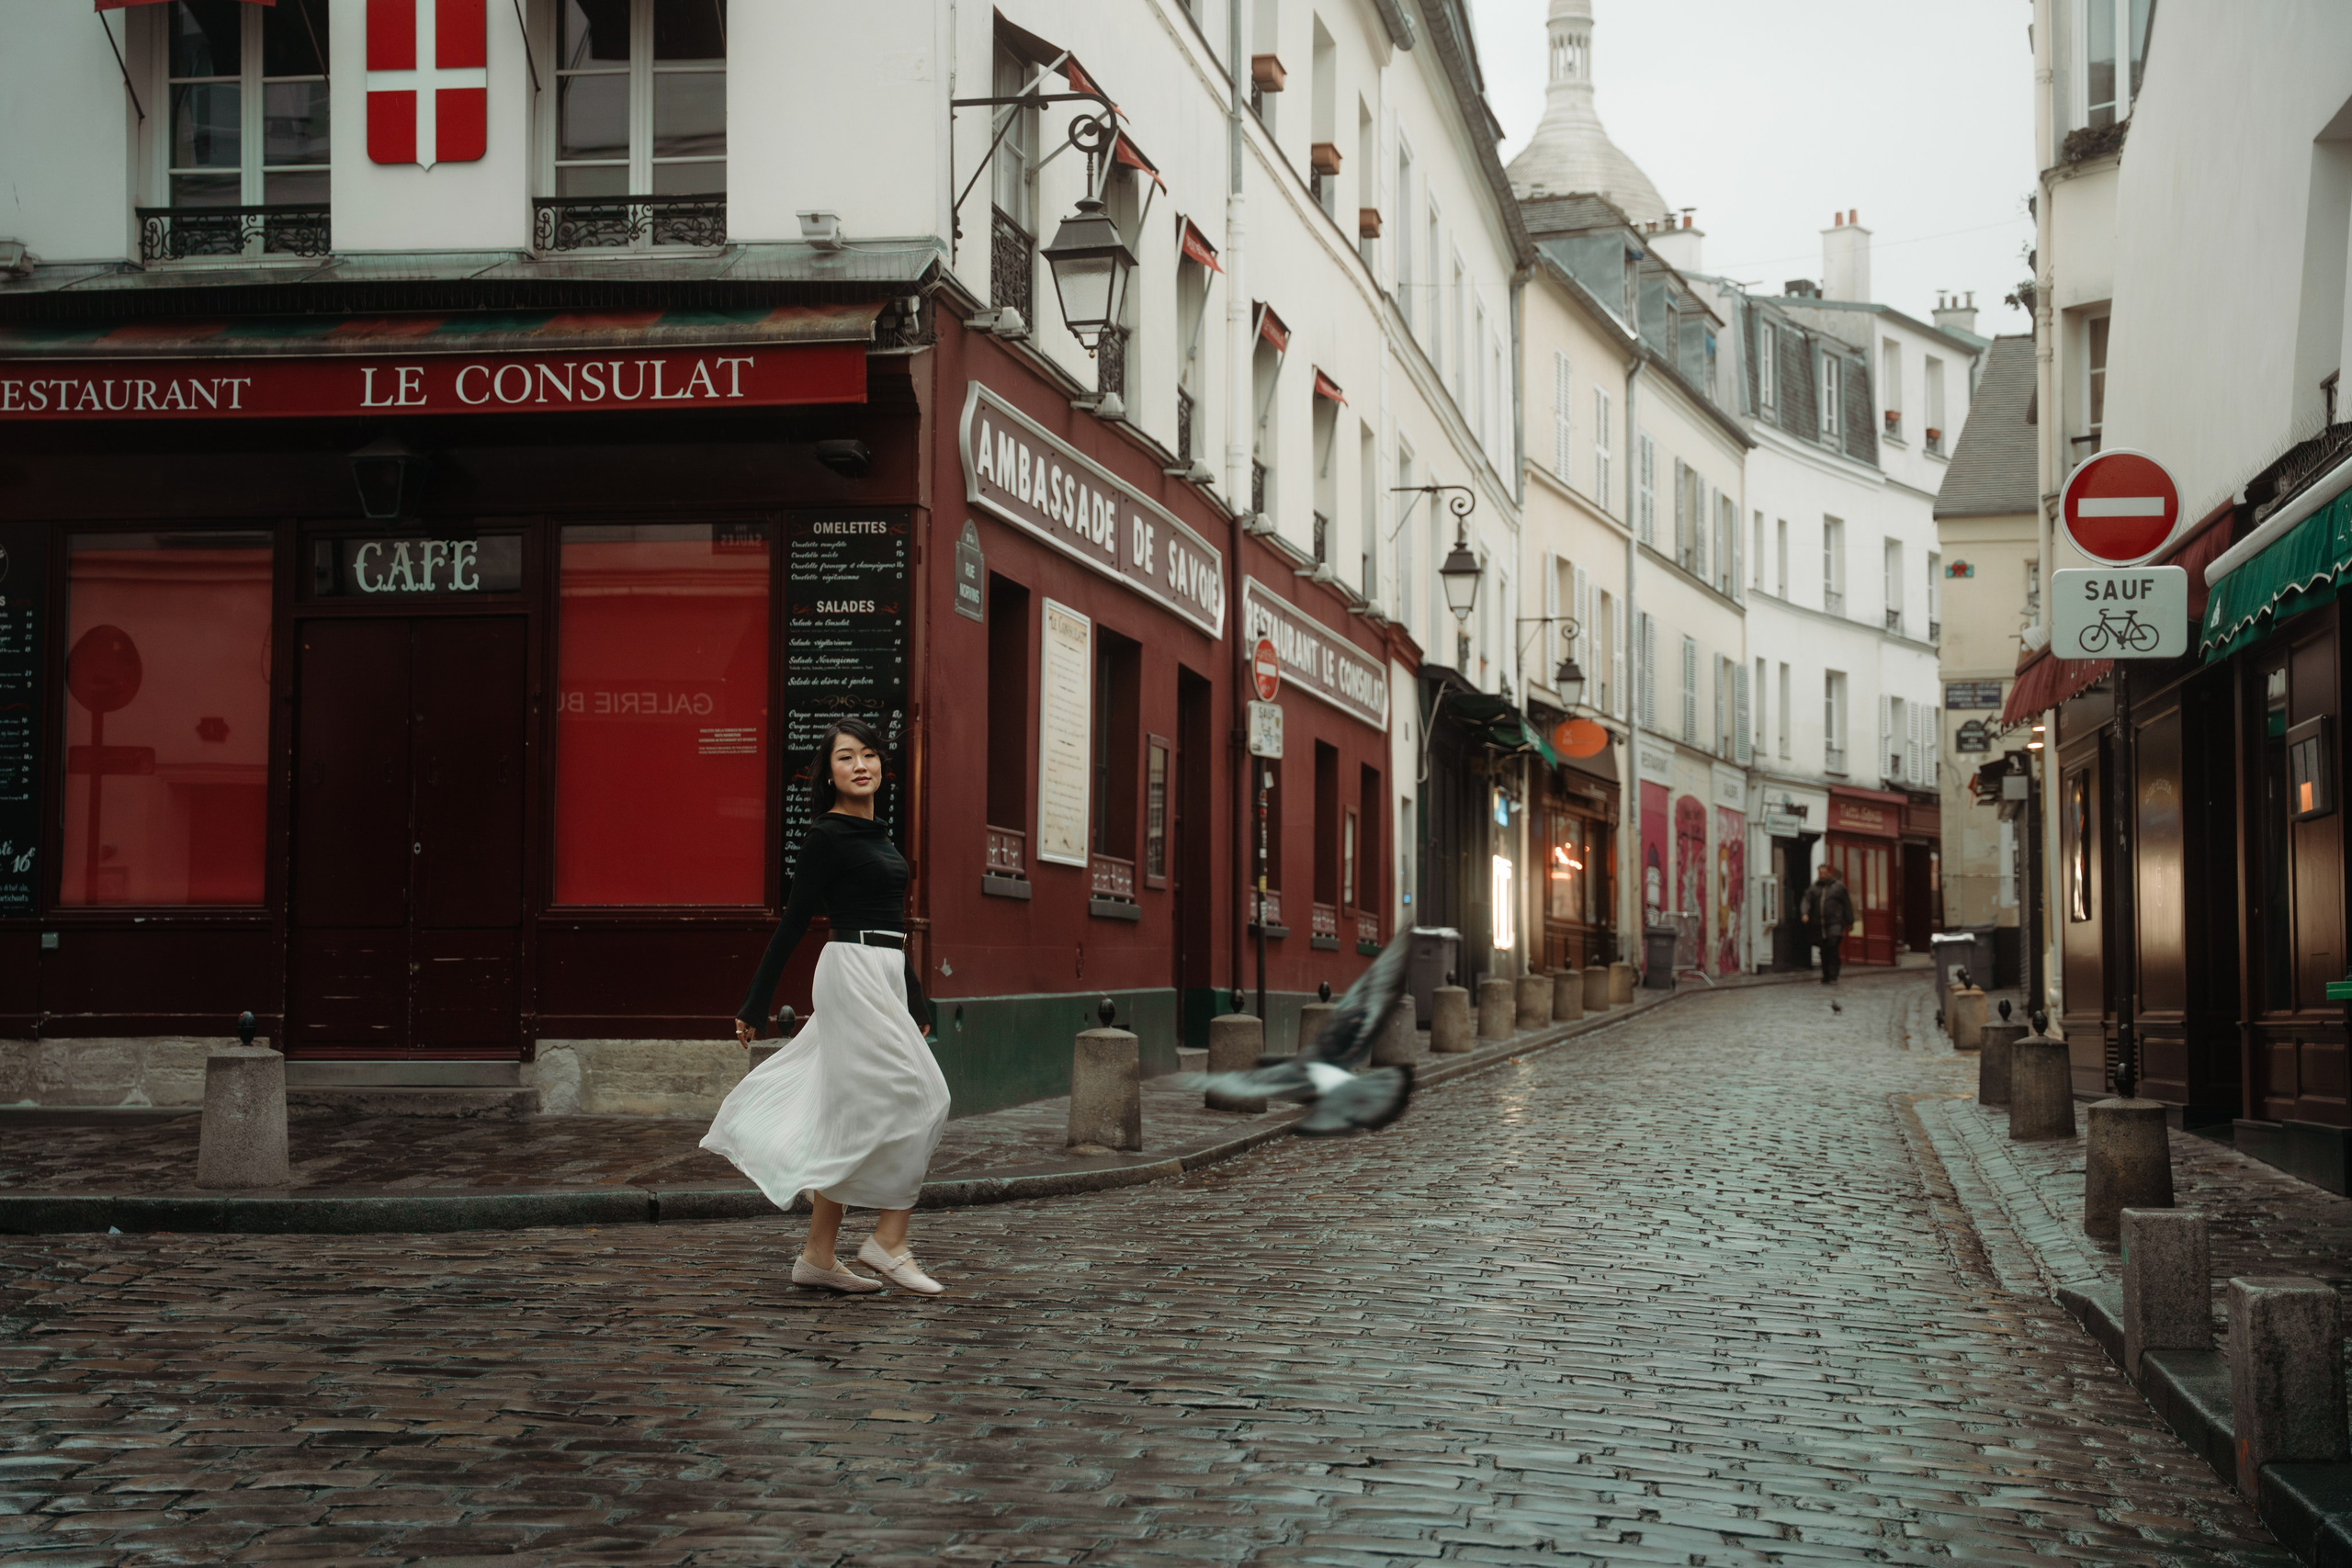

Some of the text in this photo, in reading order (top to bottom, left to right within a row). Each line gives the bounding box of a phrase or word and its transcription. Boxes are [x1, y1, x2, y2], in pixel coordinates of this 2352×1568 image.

[359, 355, 754, 407] LE CONSULAT
[0, 378, 251, 411] ESTAURANT
[977, 419, 1219, 617] AMBASSADE DE SAVOIE
[813, 521, 887, 535] OMELETTES
[353, 540, 480, 593] CAFE
[965, 562, 975, 579] RUE
[959, 582, 980, 604] NORVINS
[2085, 579, 2154, 601] SAUF
[816, 600, 876, 613] SALADES
[789, 618, 813, 627] Salade
[788, 637, 811, 646] Salade
[788, 655, 813, 664] Salade
[1245, 597, 1385, 715] RESTAURANT LE CONSULAT
[788, 677, 811, 686] Salade
[788, 709, 811, 722] Croque
[788, 721, 811, 733] Croque
[788, 731, 811, 743] Croque
[888, 742, 898, 750] 10
